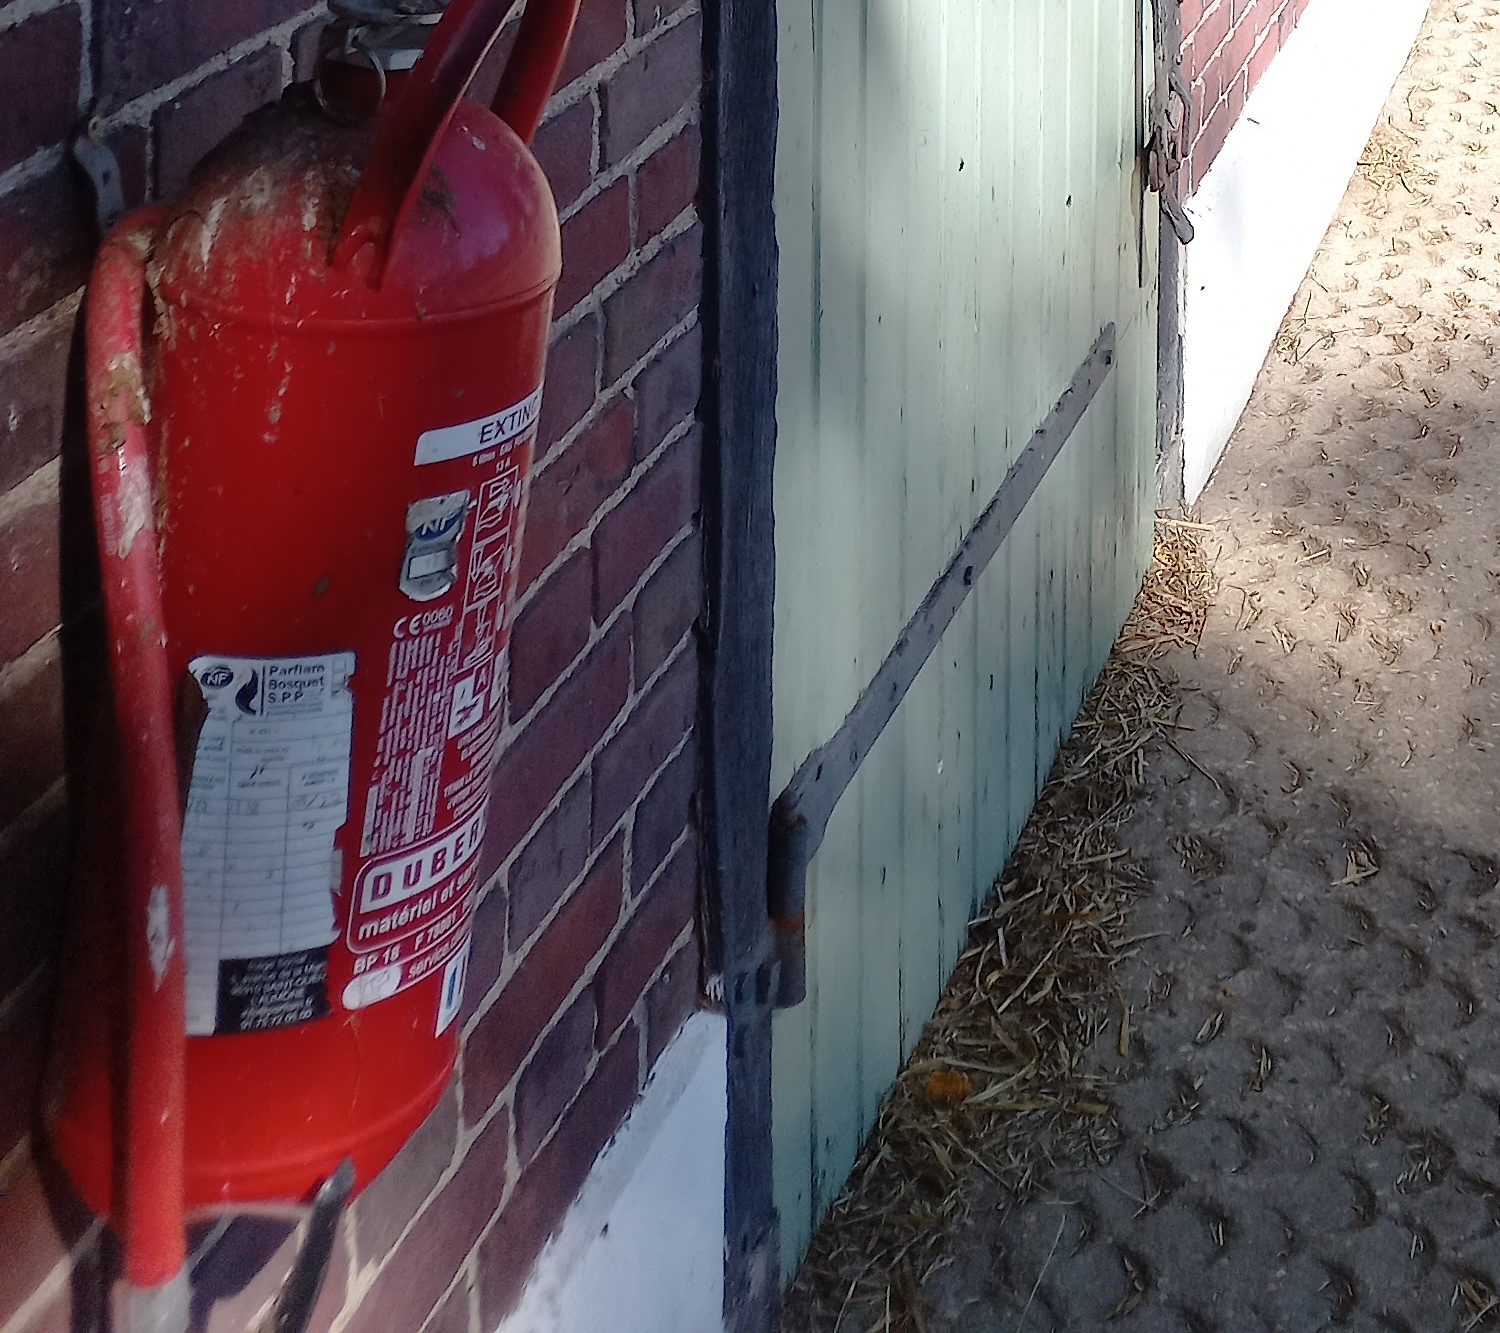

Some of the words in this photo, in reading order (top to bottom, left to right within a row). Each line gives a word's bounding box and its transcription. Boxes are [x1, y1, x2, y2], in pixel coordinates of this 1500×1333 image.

[358, 890, 436, 941] matériel
[353, 953, 377, 975] BP
[383, 944, 401, 966] 18
